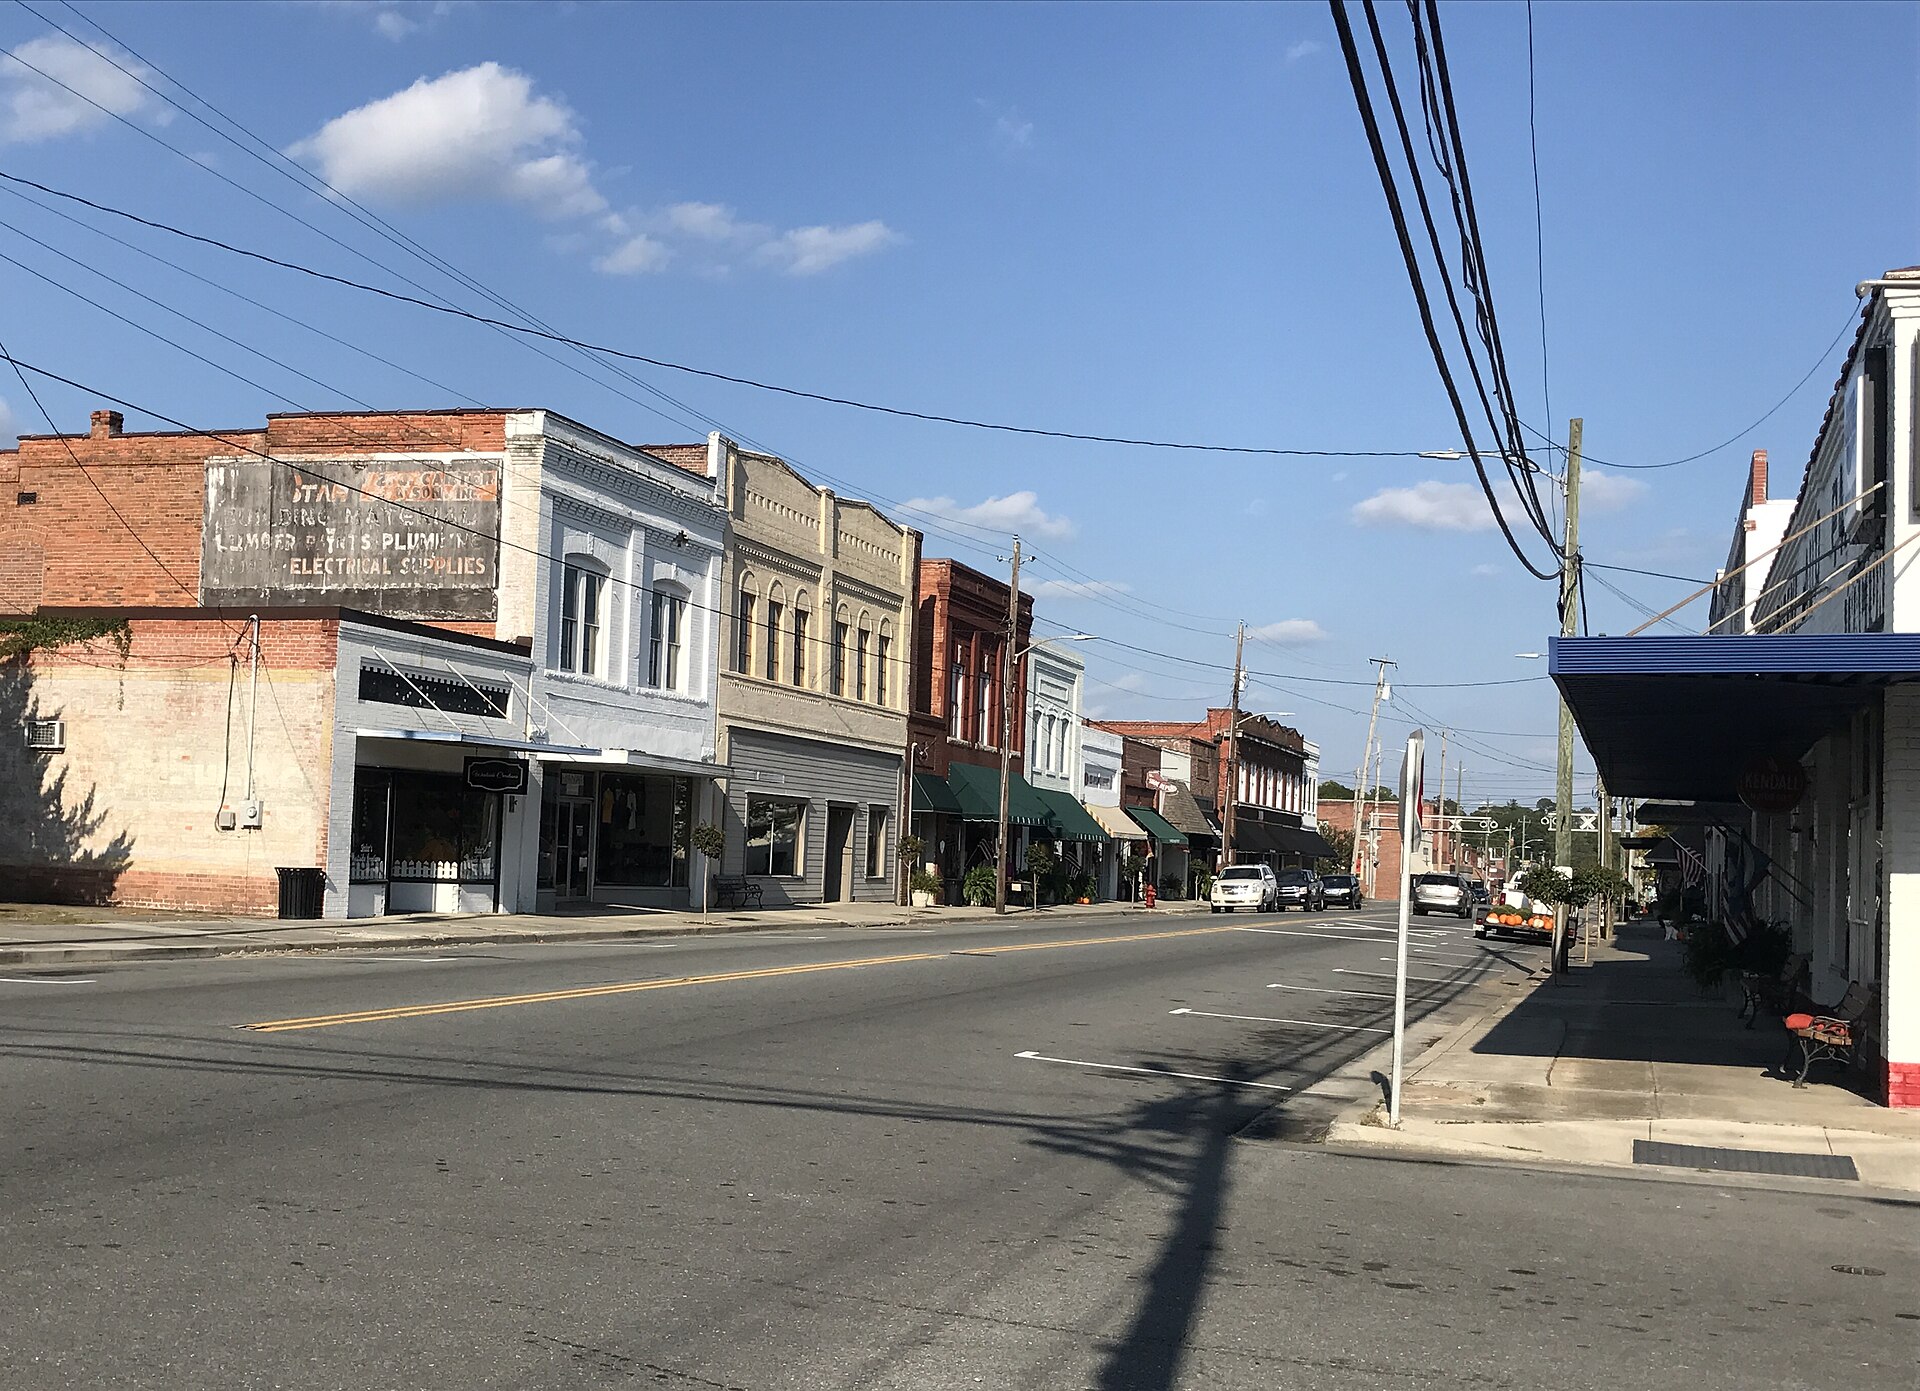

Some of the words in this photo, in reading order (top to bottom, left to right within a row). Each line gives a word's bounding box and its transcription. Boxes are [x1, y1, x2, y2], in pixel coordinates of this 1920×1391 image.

[290, 557, 392, 576] ELECTRICAL
[399, 556, 487, 576] SUPPLIES
[1745, 773, 1799, 790] KENDALL
